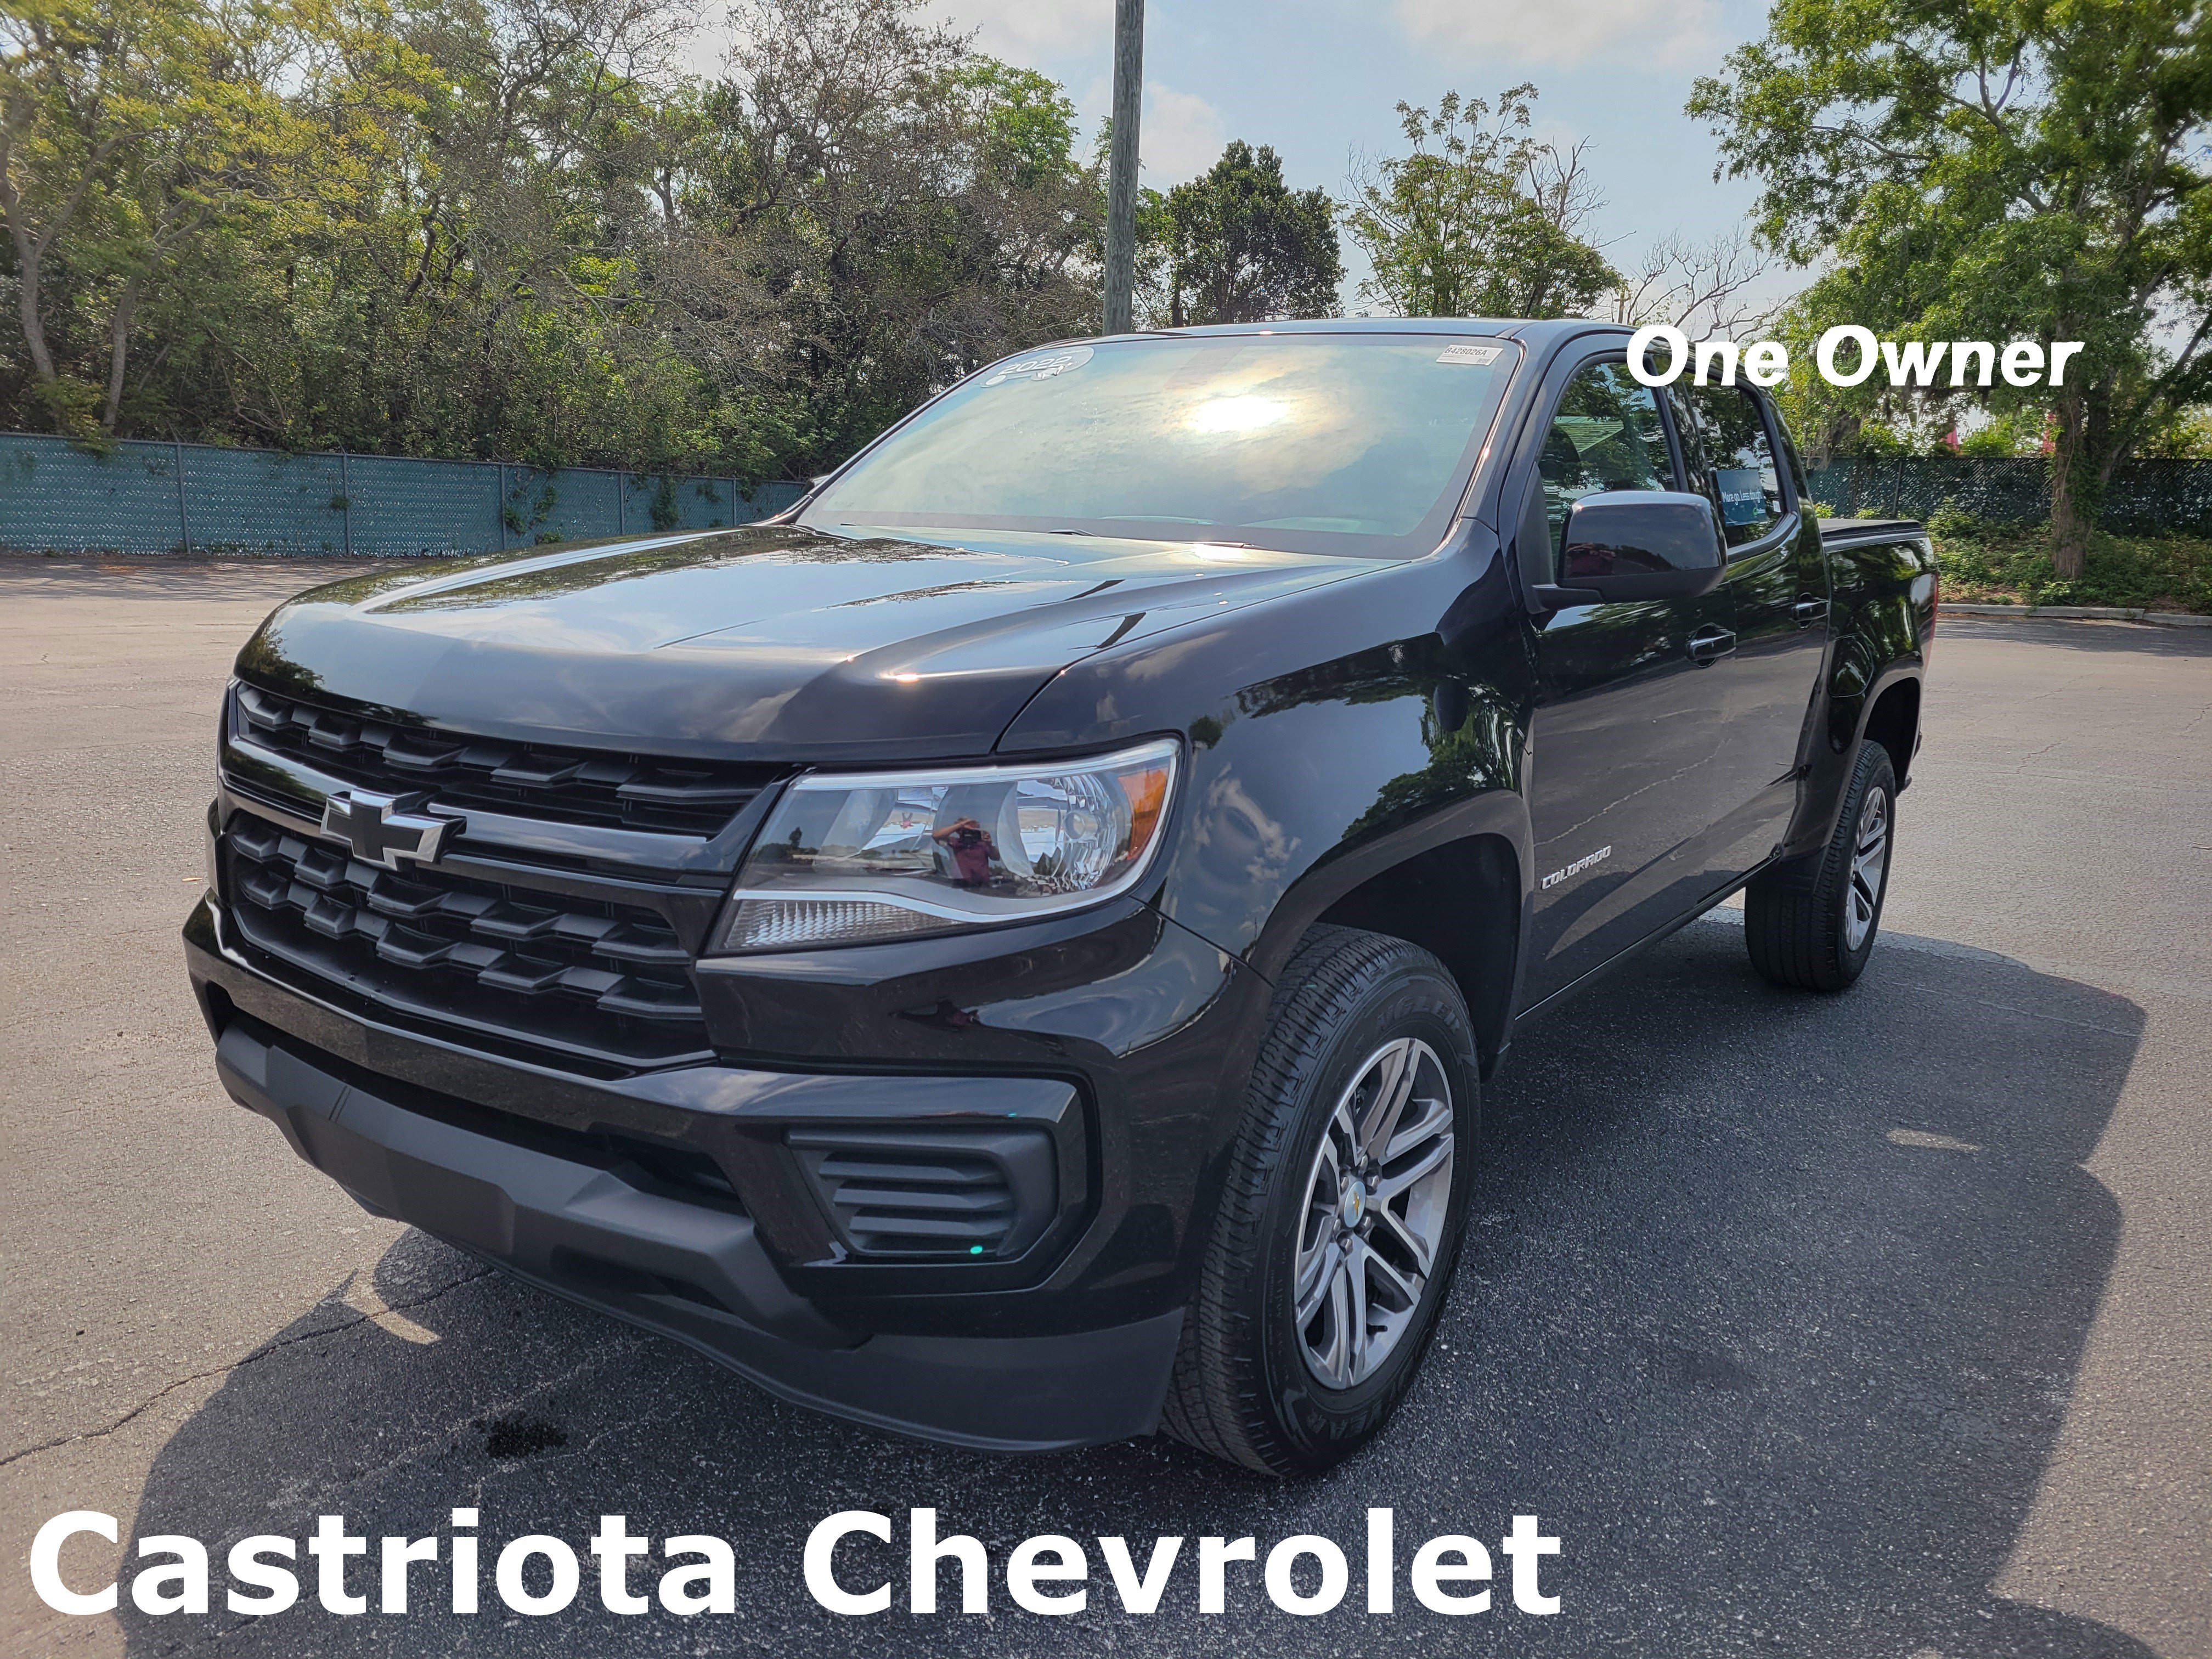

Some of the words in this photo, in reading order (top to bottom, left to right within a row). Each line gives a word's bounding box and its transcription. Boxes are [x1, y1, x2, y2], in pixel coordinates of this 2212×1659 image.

[997, 356, 1073, 376] 2022
[1722, 491, 1734, 503] More
[1542, 845, 1612, 890] COLORADO
